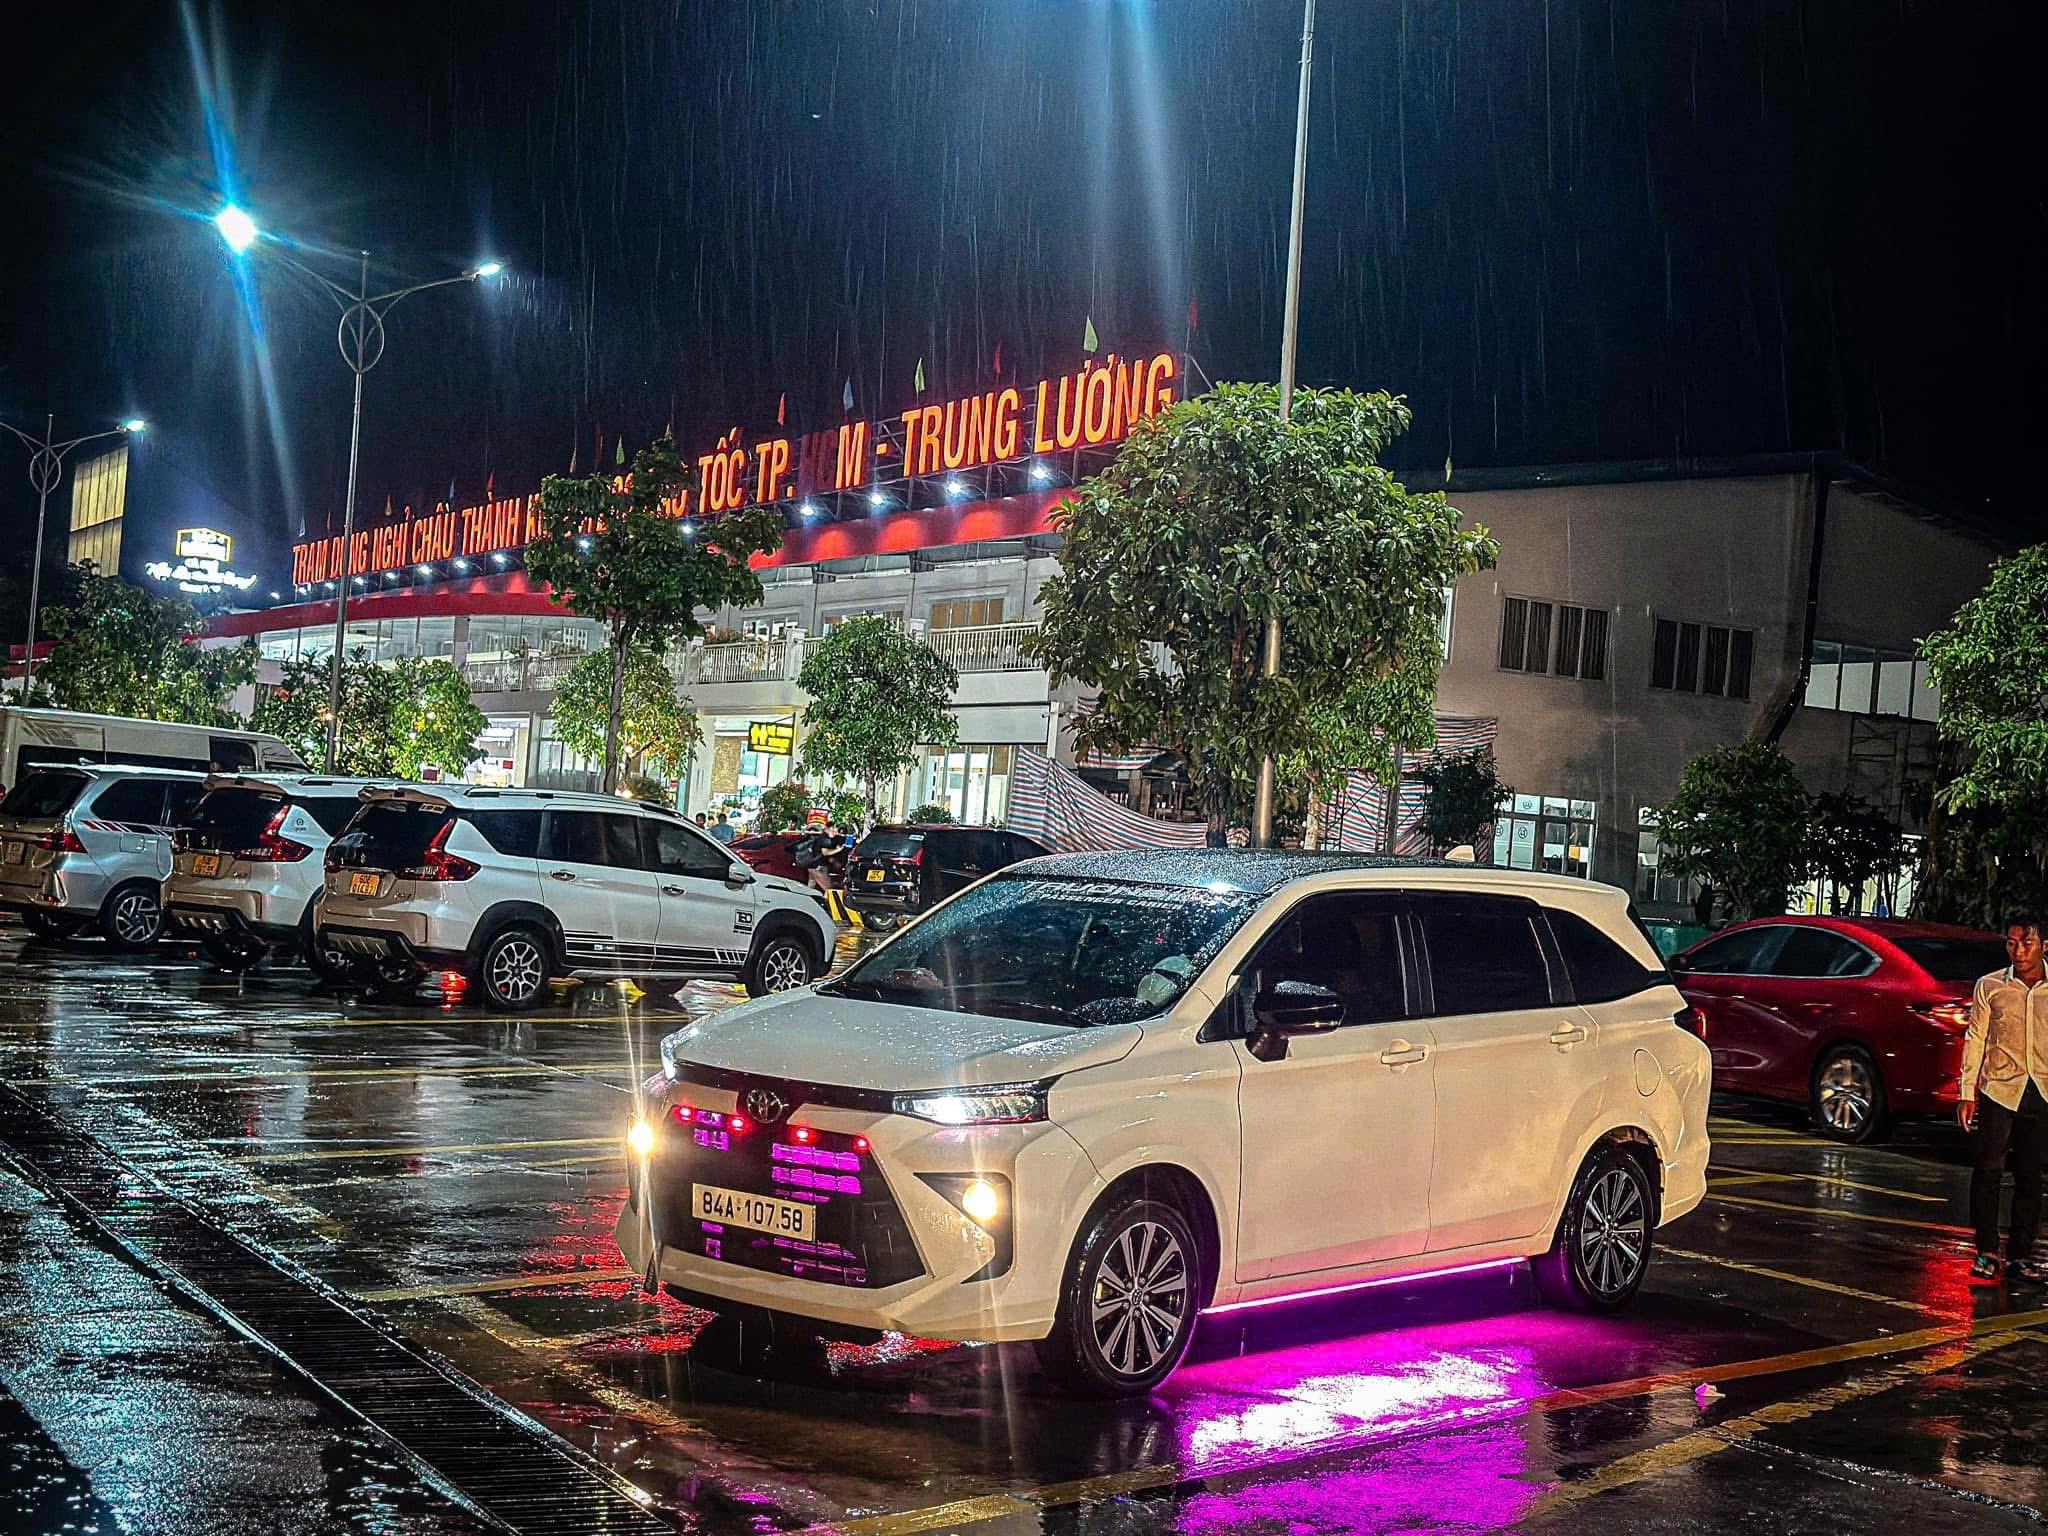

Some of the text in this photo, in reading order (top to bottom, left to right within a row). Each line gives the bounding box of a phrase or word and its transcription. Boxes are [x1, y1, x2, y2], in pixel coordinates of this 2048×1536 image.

[698, 426, 746, 515] TỐC
[755, 438, 794, 505] TP.
[900, 387, 1019, 478] TRUNG
